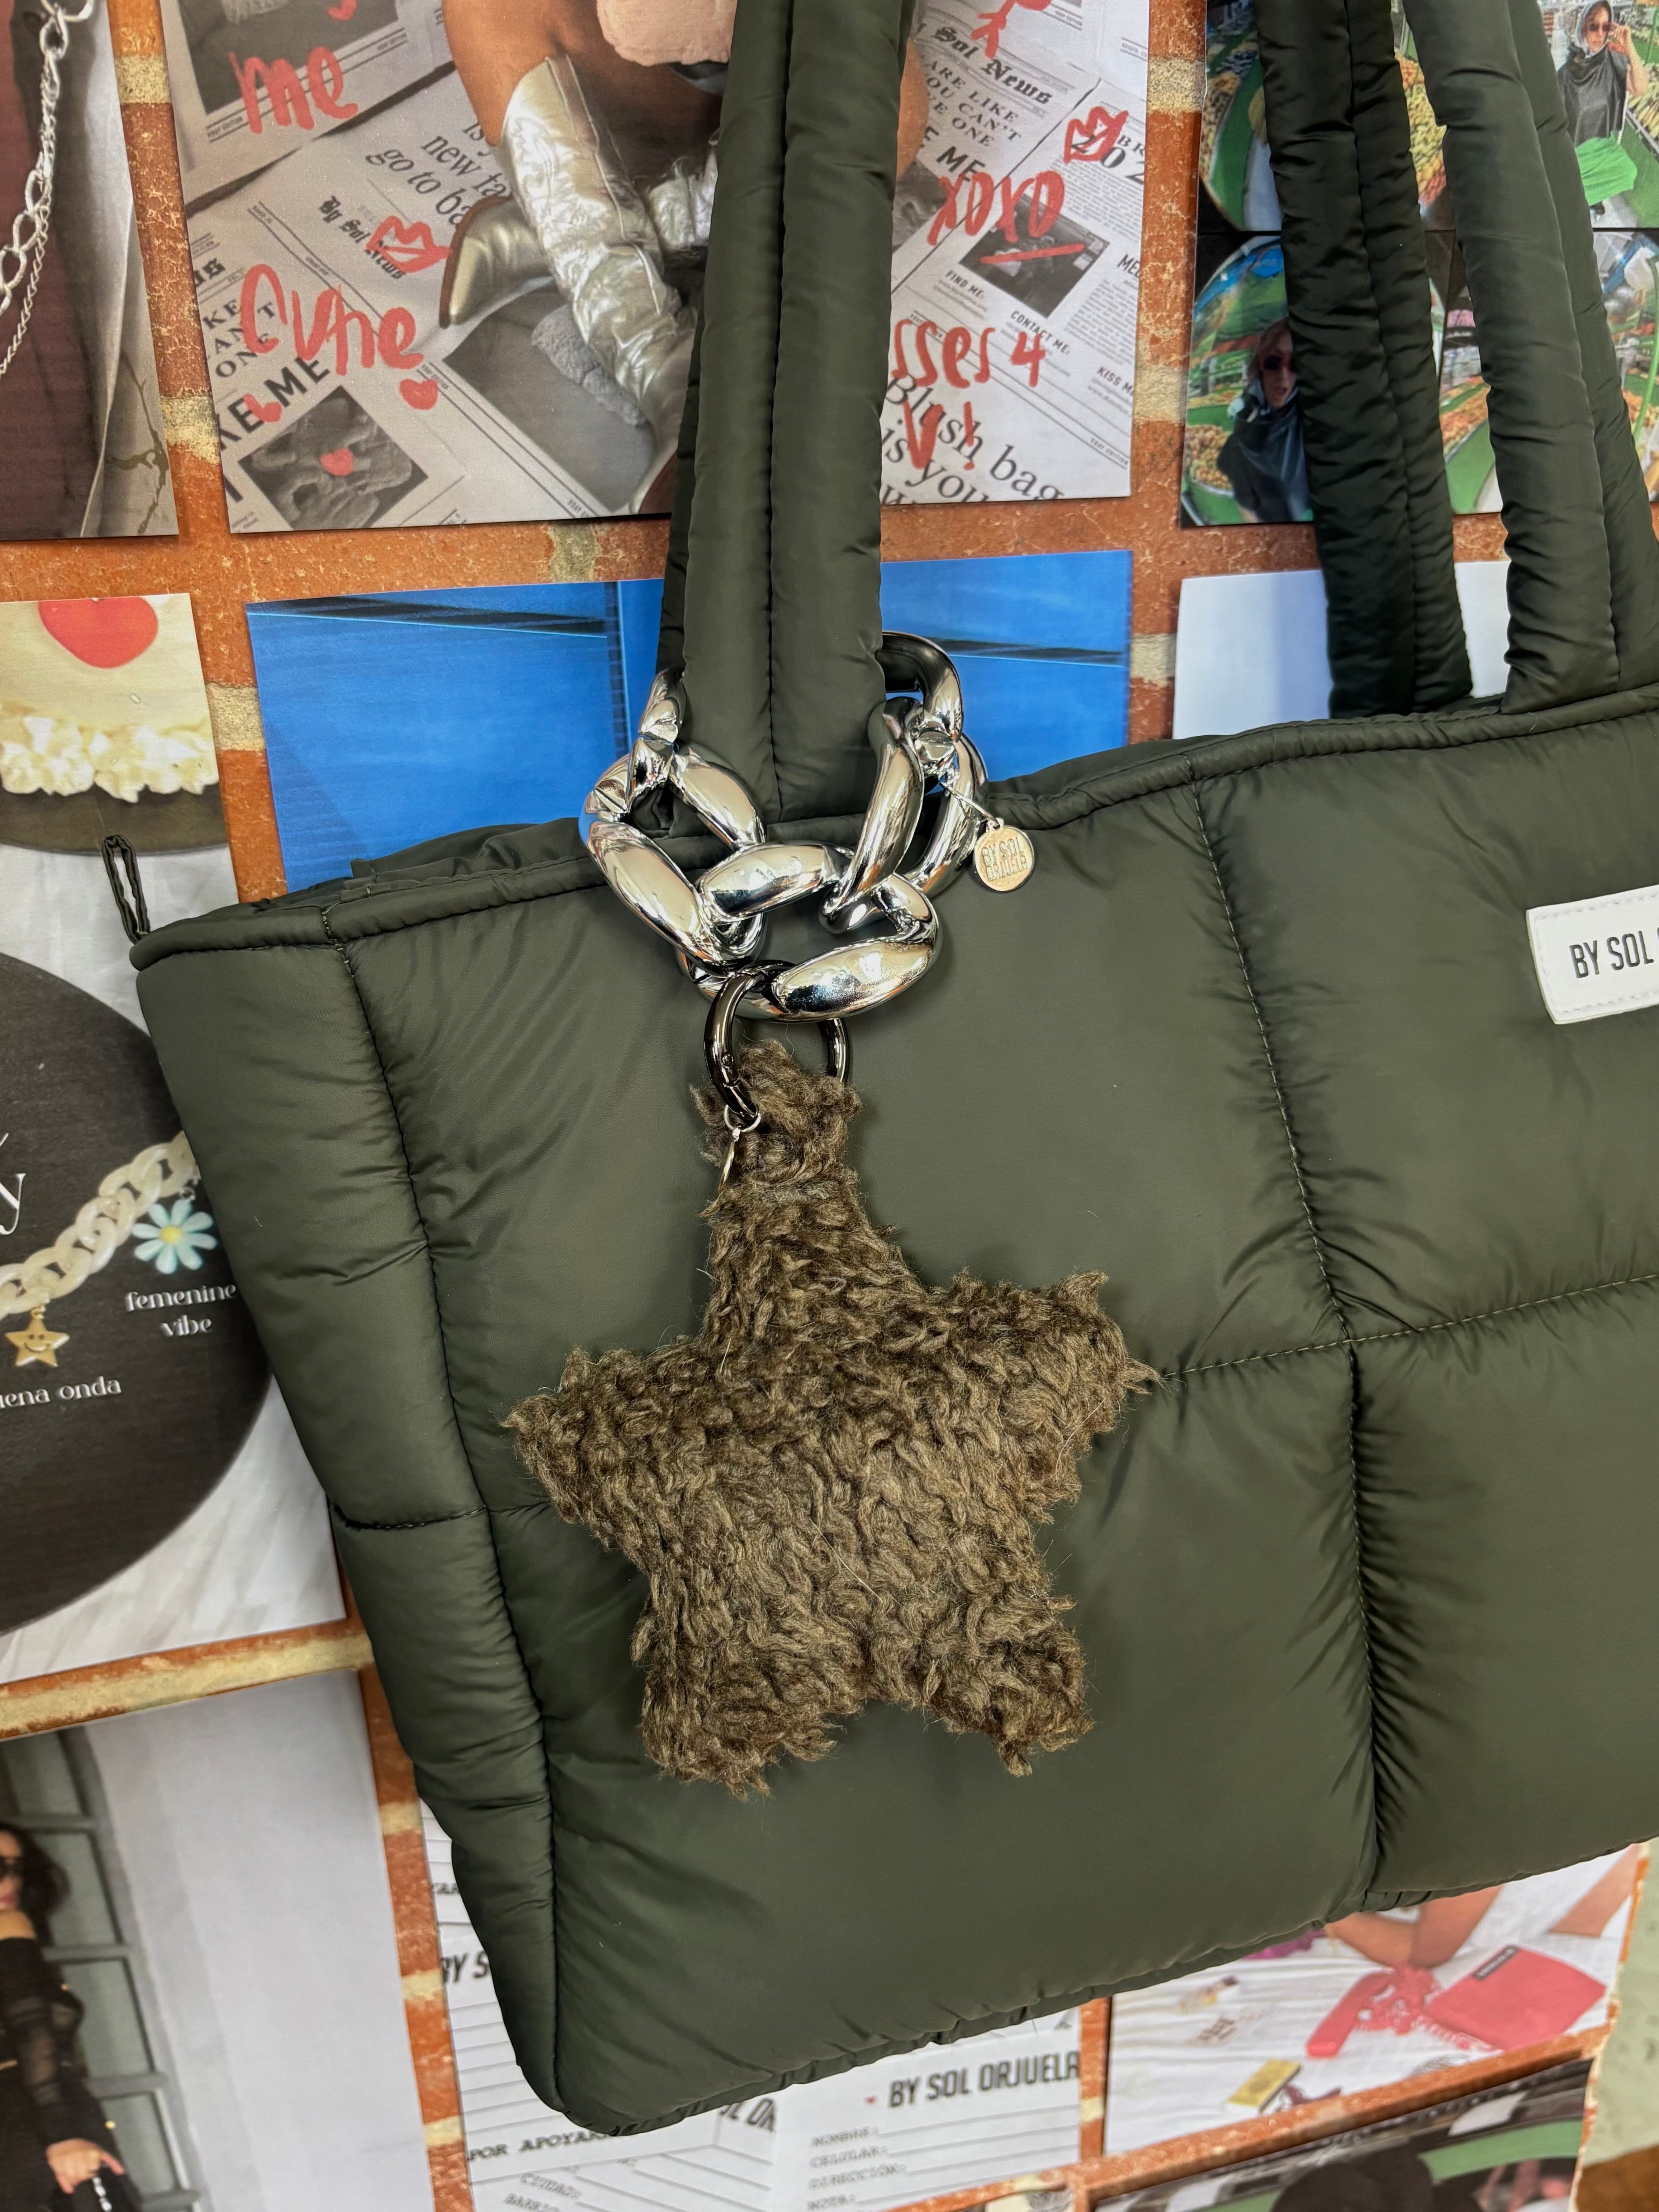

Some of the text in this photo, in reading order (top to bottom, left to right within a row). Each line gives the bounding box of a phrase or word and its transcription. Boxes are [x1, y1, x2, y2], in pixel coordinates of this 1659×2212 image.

[228, 46, 358, 134] me
[926, 77, 954, 99] OU
[969, 91, 1019, 123] LIKE
[365, 149, 415, 172] go
[407, 172, 442, 194] to
[420, 135, 481, 176] new
[944, 270, 969, 288] FIND
[263, 356, 331, 408] ME
[1097, 366, 1122, 386] KISS
[1569, 940, 1600, 979] BY
[1606, 931, 1654, 971] SOL
[125, 1284, 236, 1313] femenine
[159, 1314, 213, 1337] vibe
[57, 1376, 122, 1400] onda
[889, 2050, 1080, 2108] BY SOL ORJUELA
